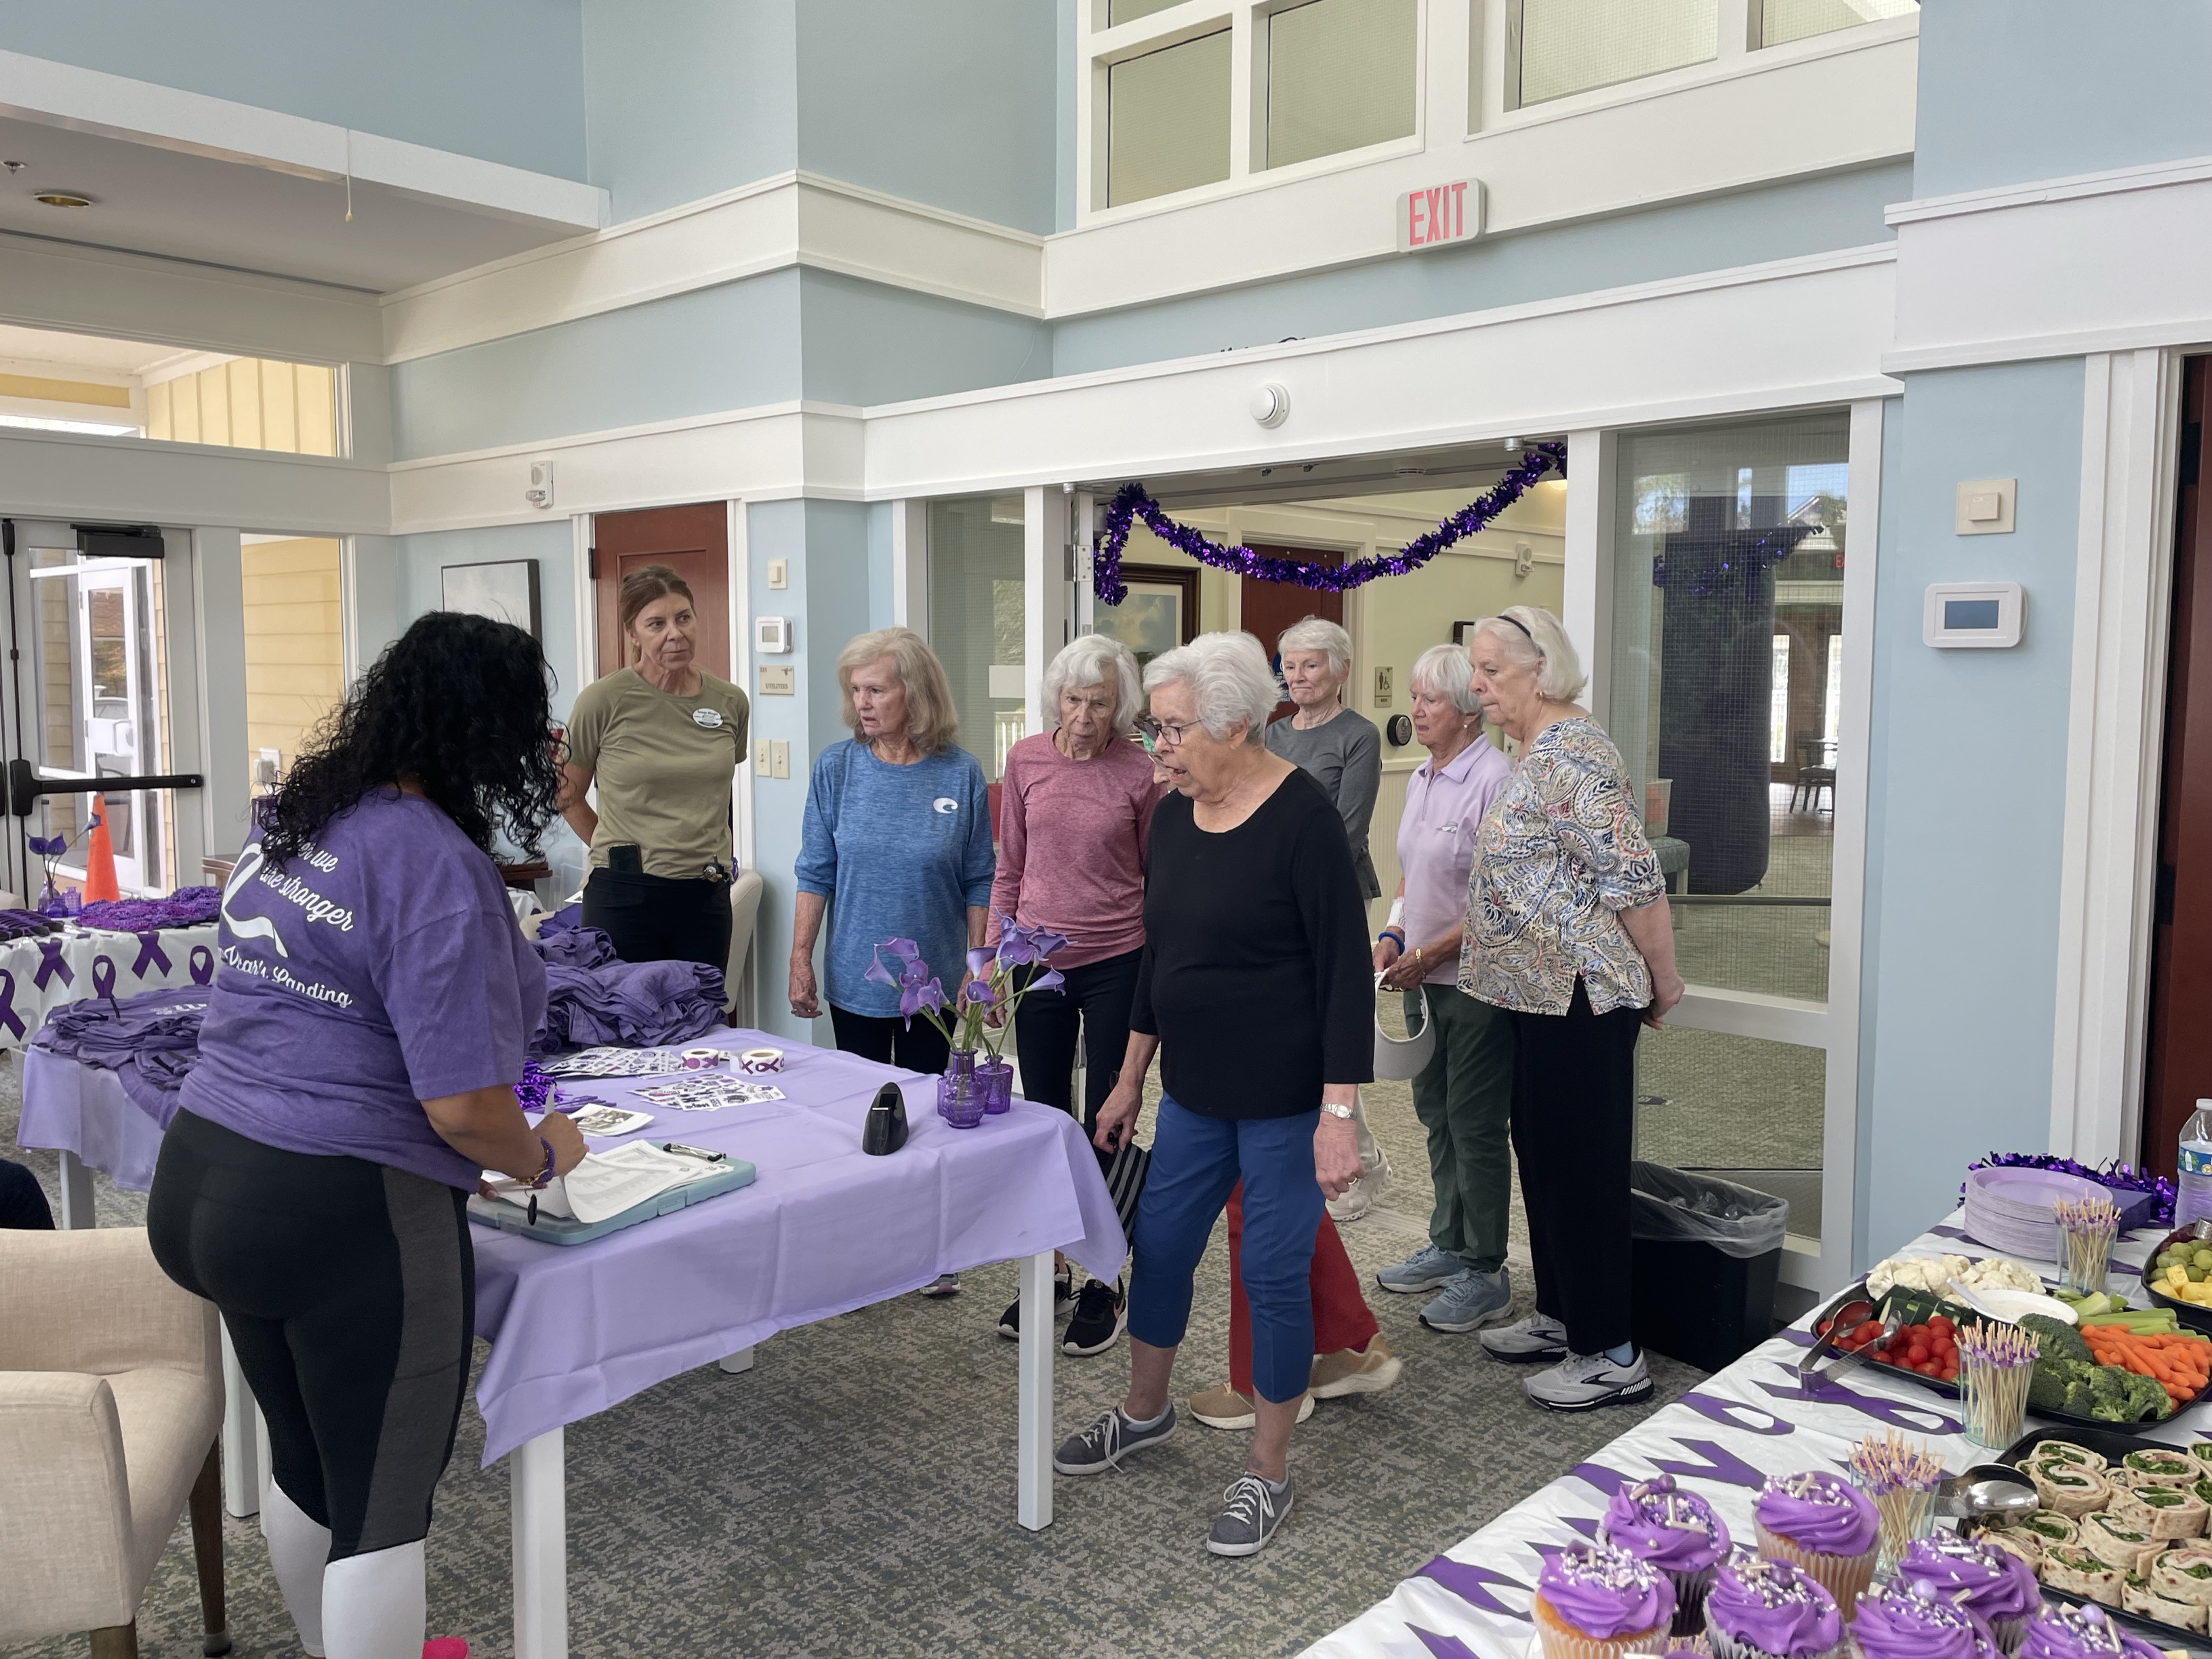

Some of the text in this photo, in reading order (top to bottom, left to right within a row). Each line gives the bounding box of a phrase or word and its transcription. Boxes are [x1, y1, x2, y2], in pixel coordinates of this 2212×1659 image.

[1410, 182, 1467, 246] EXIT
[310, 850, 338, 873] we
[279, 876, 353, 931] stronger
[272, 966, 352, 1008] Landing
